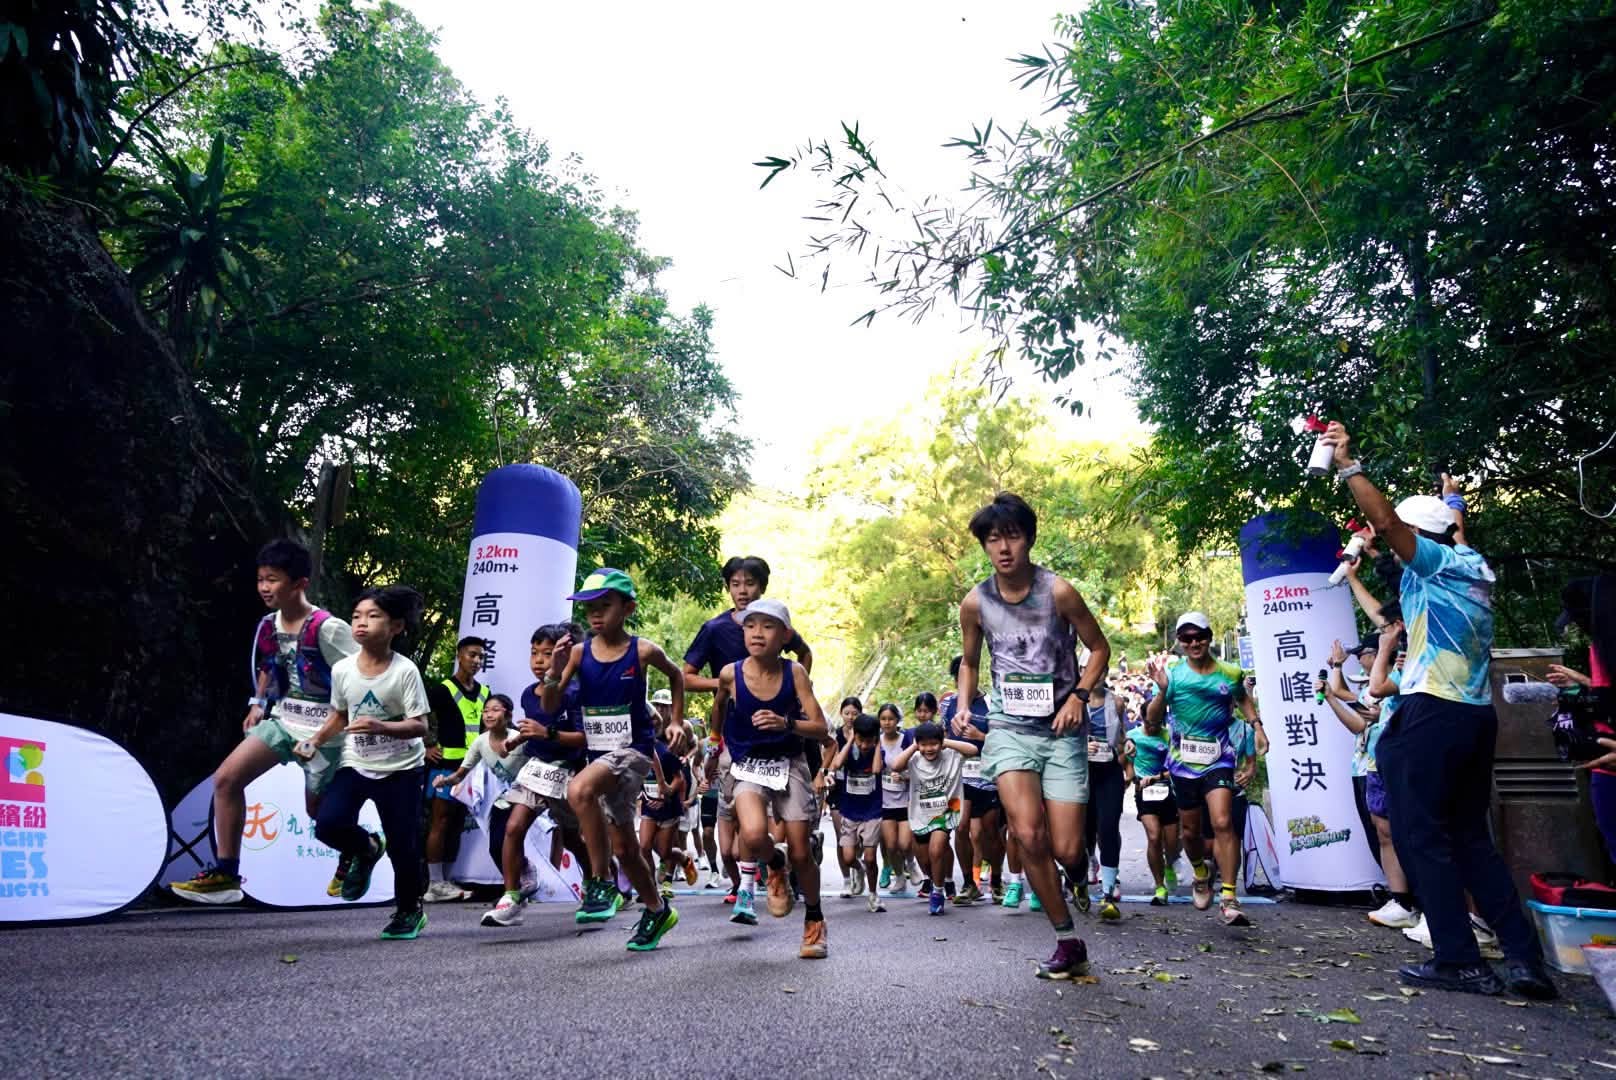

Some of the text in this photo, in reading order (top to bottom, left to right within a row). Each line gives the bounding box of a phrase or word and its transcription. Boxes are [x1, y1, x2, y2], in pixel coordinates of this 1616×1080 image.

[475, 545, 519, 560] 3.2km
[472, 560, 519, 575] 240m+
[1263, 585, 1310, 601] 3.2km
[1263, 600, 1313, 616] 240m+
[1003, 687, 1050, 701] 特邀 8001
[304, 706, 328, 718] 8006
[1273, 629, 1328, 792] 高峰對決
[604, 721, 629, 734] 8004
[1198, 745, 1216, 754] 8058
[543, 769, 567, 784] 8032
